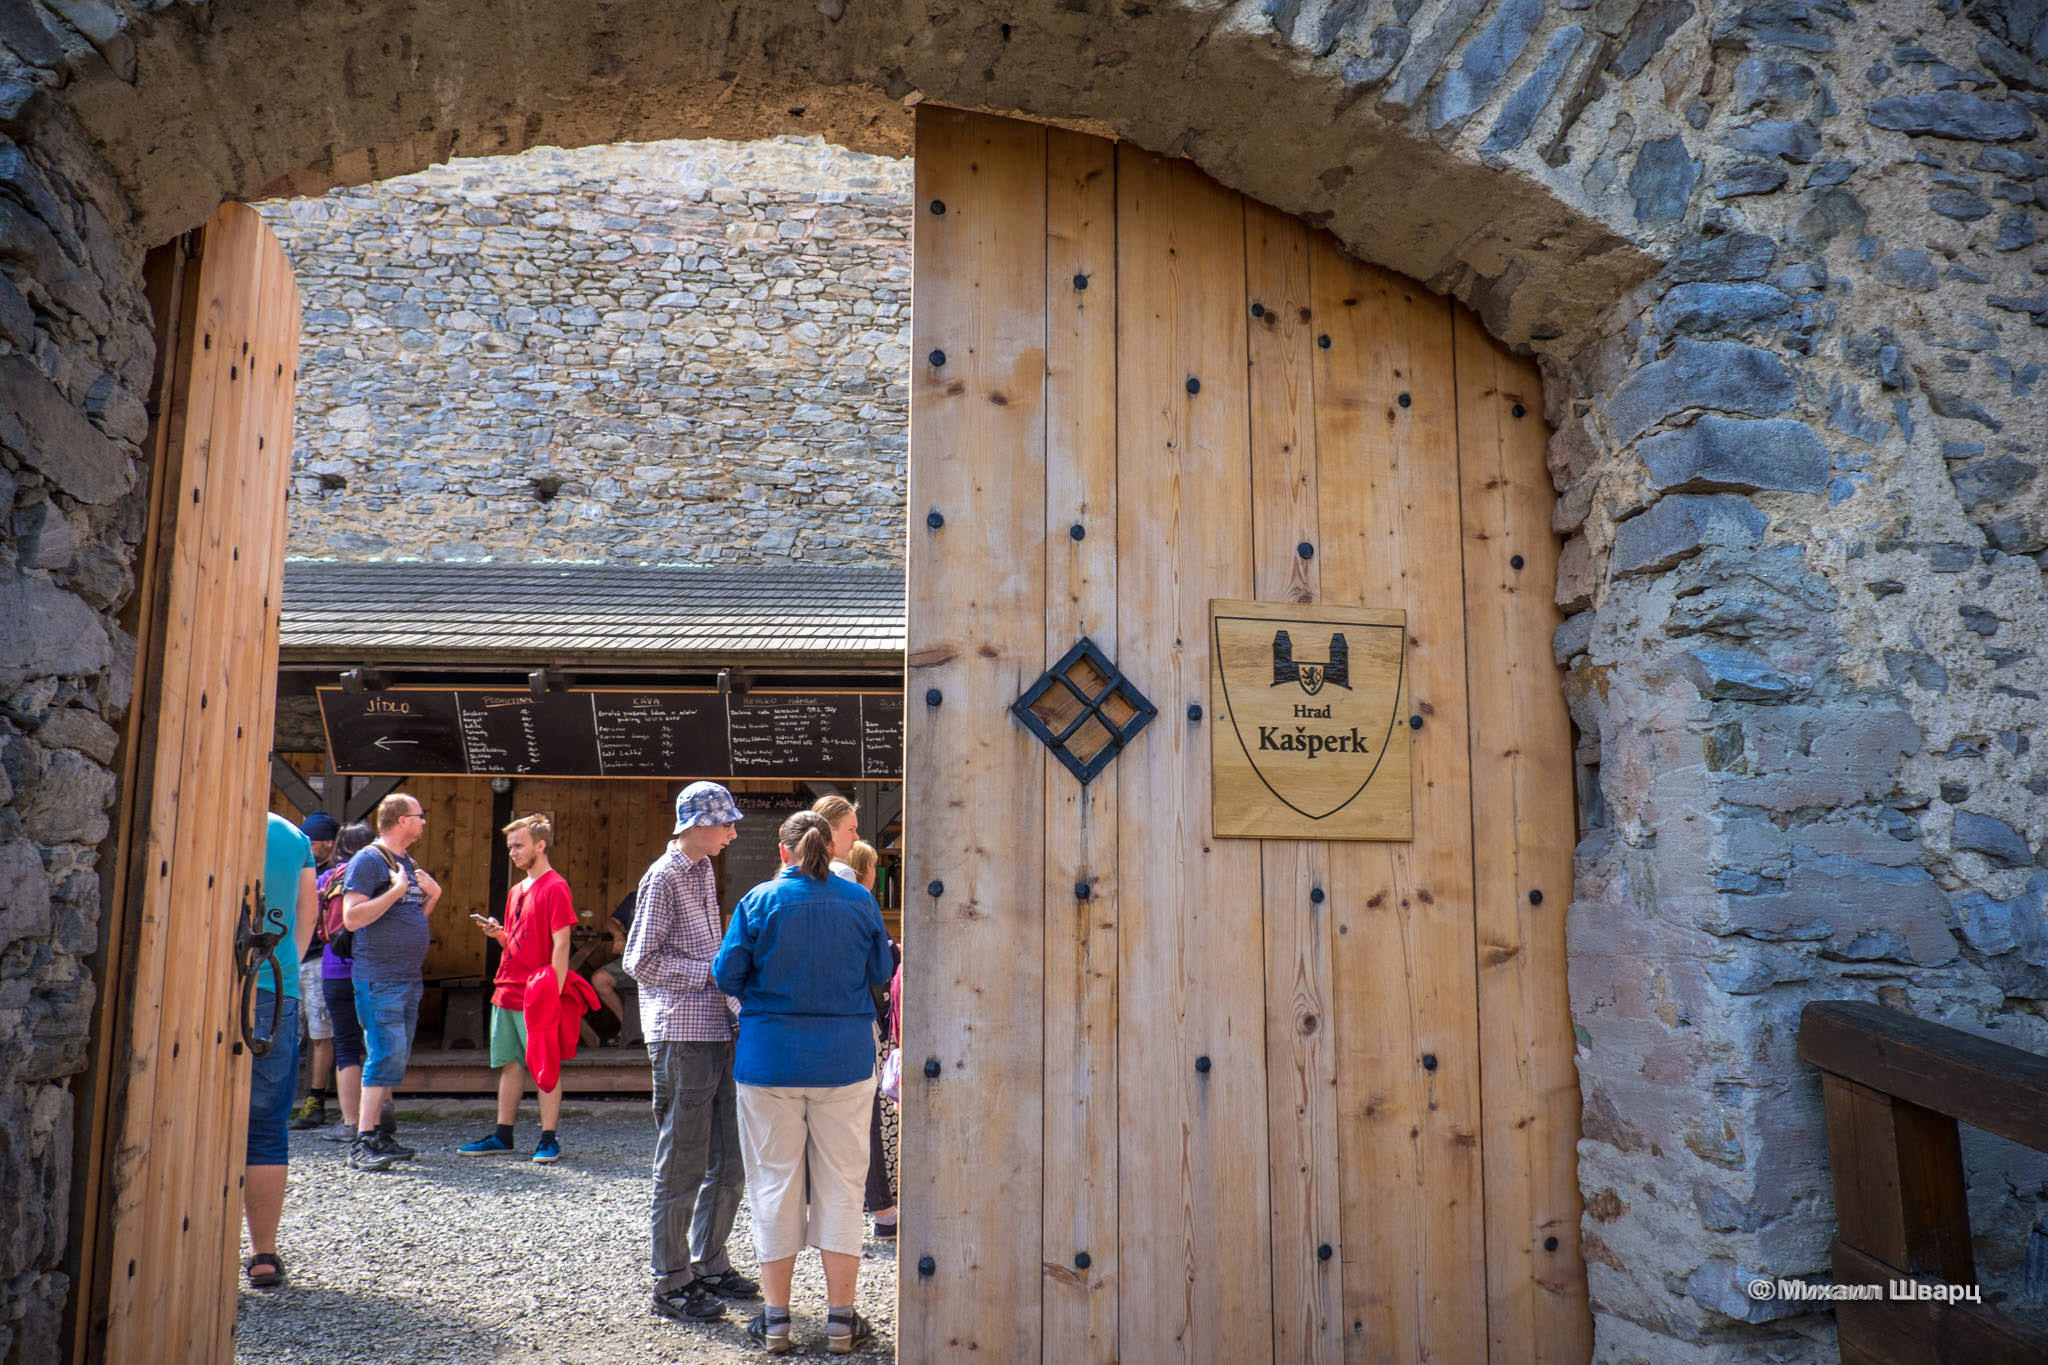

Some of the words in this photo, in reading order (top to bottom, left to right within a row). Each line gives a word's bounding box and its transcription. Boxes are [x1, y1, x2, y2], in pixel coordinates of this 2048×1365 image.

[366, 696, 400, 714] JÍDLO
[1293, 704, 1331, 719] Hrad
[1258, 726, 1369, 760] Kašperk
